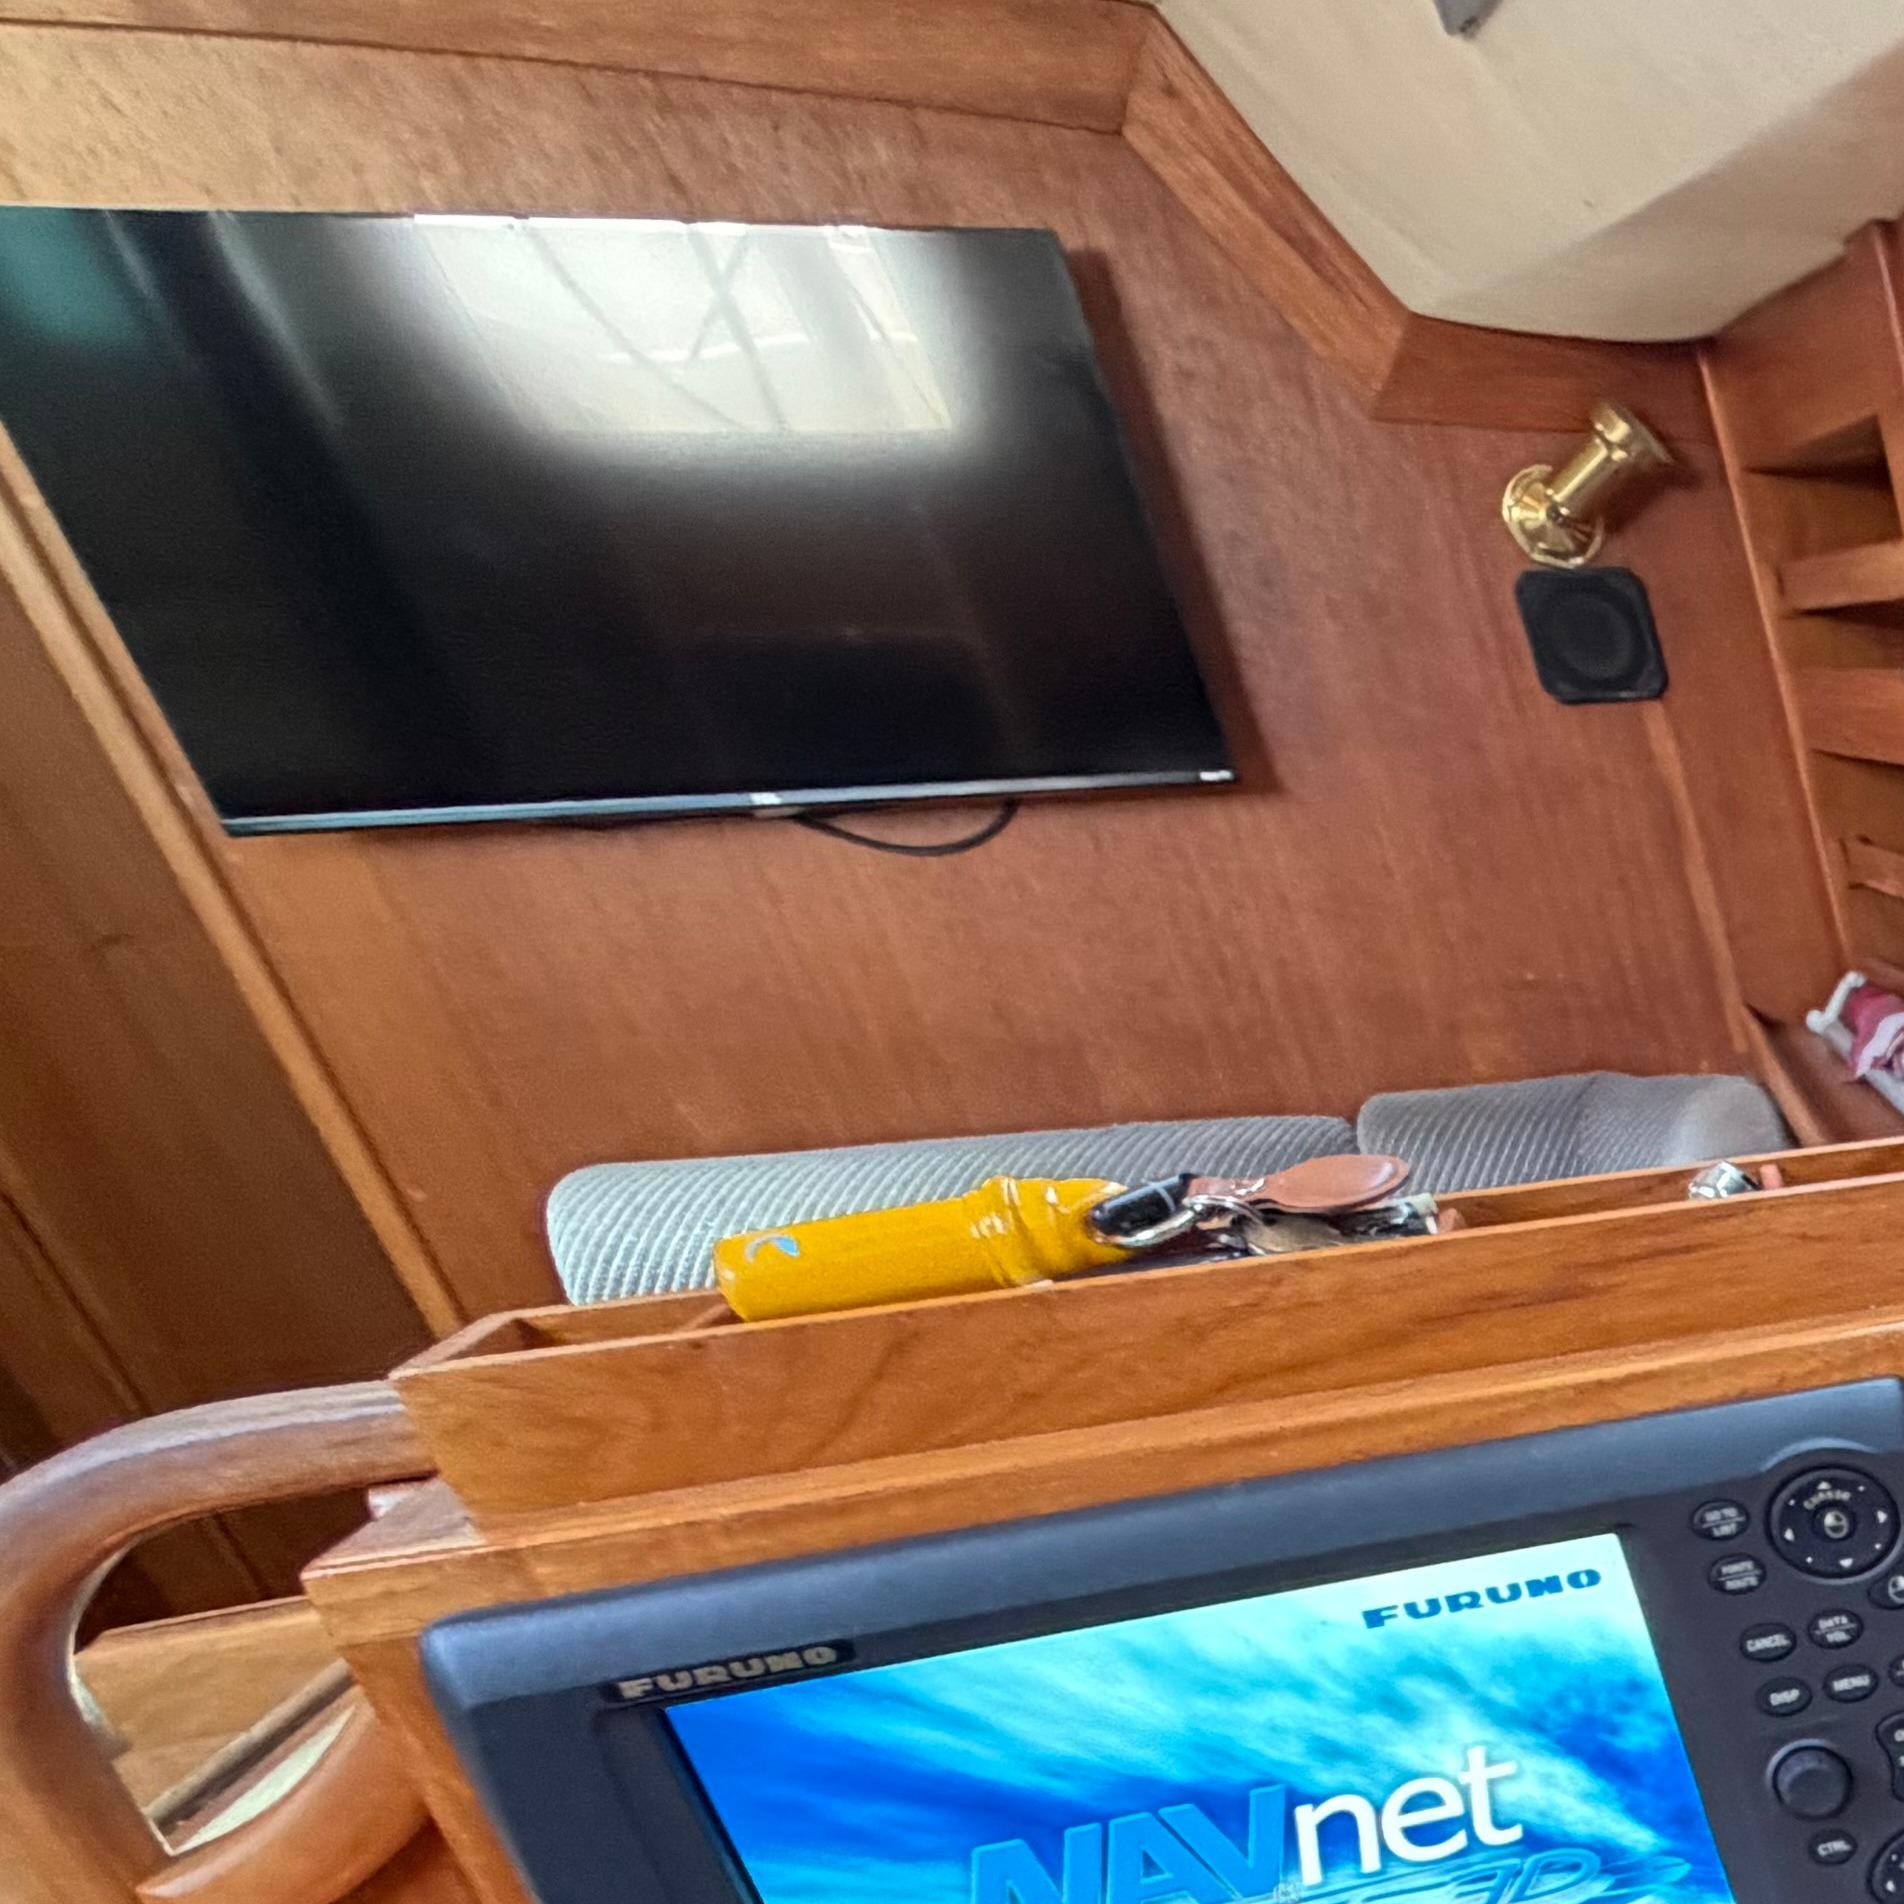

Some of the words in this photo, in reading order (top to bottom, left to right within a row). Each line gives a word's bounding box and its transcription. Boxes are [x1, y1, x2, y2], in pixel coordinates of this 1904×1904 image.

[1361, 1568, 1602, 1630] FURUNO
[1746, 1633, 1792, 1653] CANCEL
[618, 1645, 838, 1700] FURUNO
